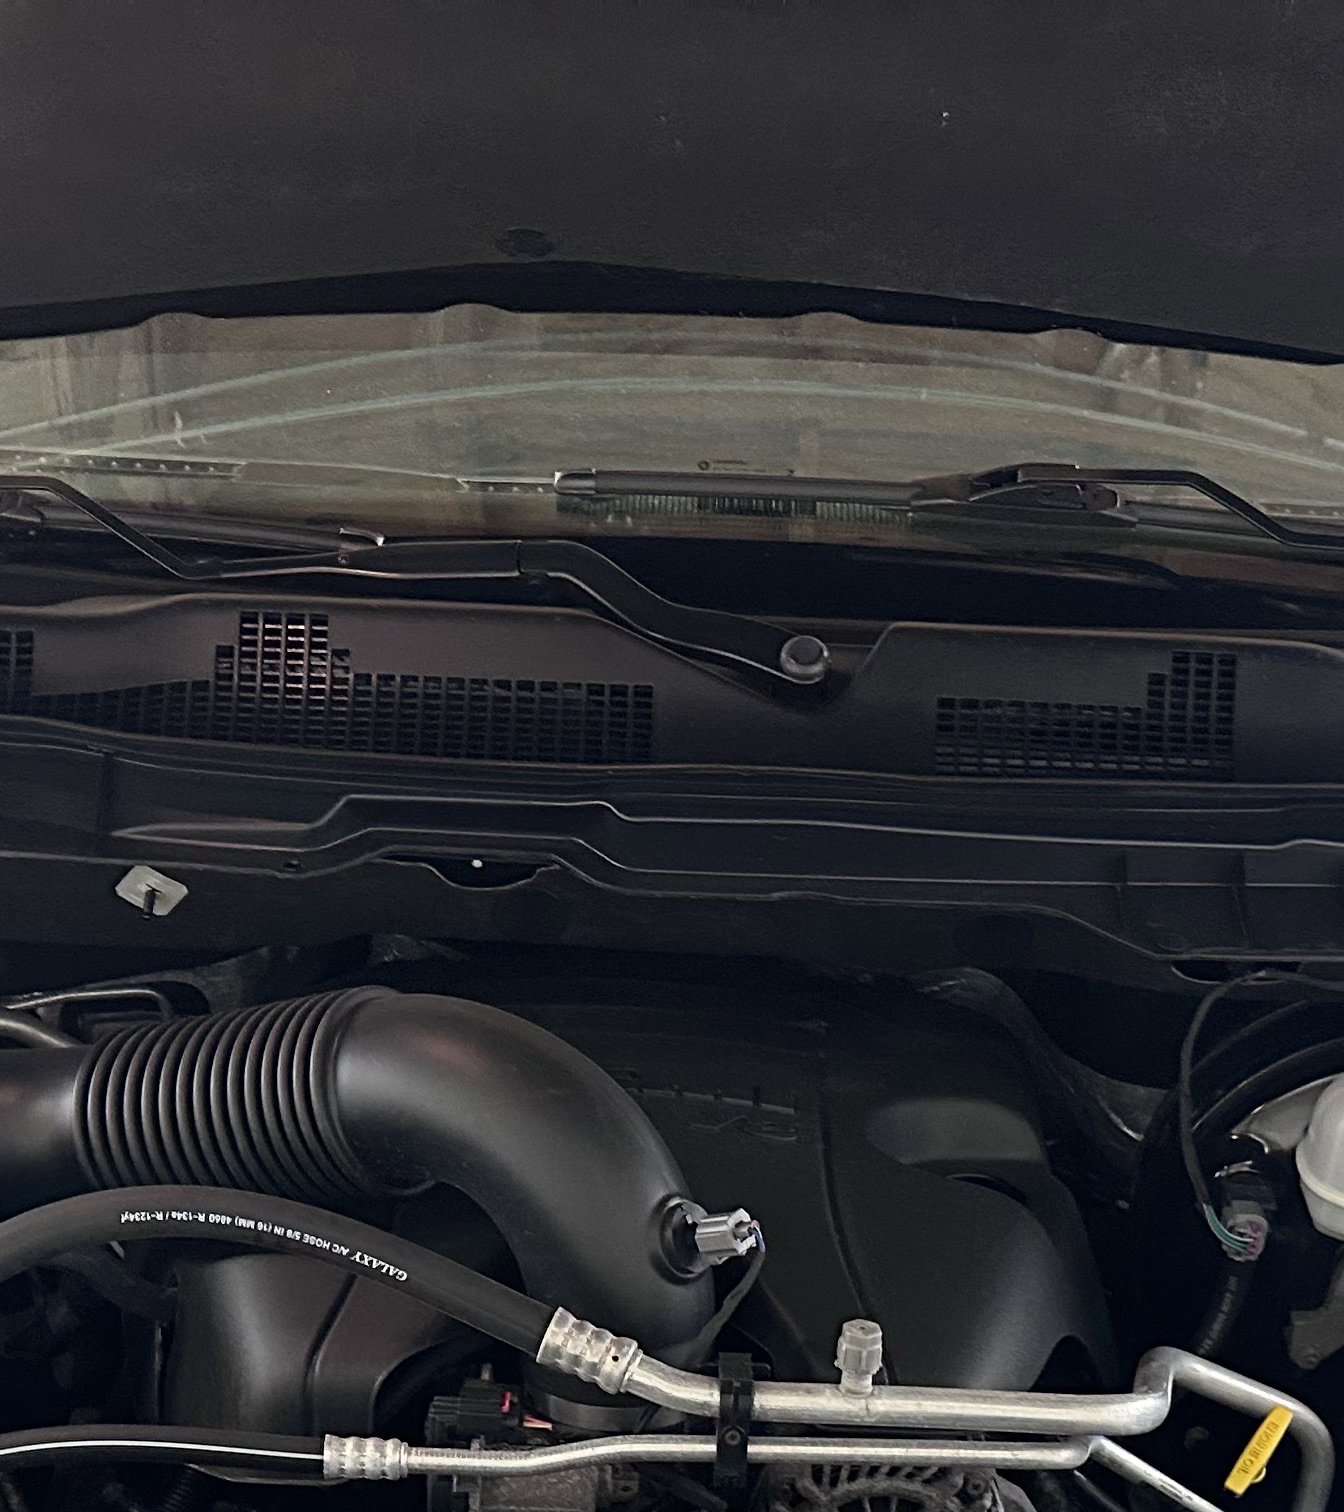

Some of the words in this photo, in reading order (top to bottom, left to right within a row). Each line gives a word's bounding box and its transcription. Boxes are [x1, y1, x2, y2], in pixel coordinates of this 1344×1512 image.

[119, 1210, 164, 1225] R-1234yf
[171, 1210, 206, 1223] R-134a
[234, 1216, 256, 1230] MM)
[273, 1225, 285, 1237] IN
[286, 1228, 302, 1241] 5/8
[302, 1233, 331, 1250] HOSE
[331, 1243, 350, 1256] A/C
[349, 1250, 409, 1283] GALAXY
